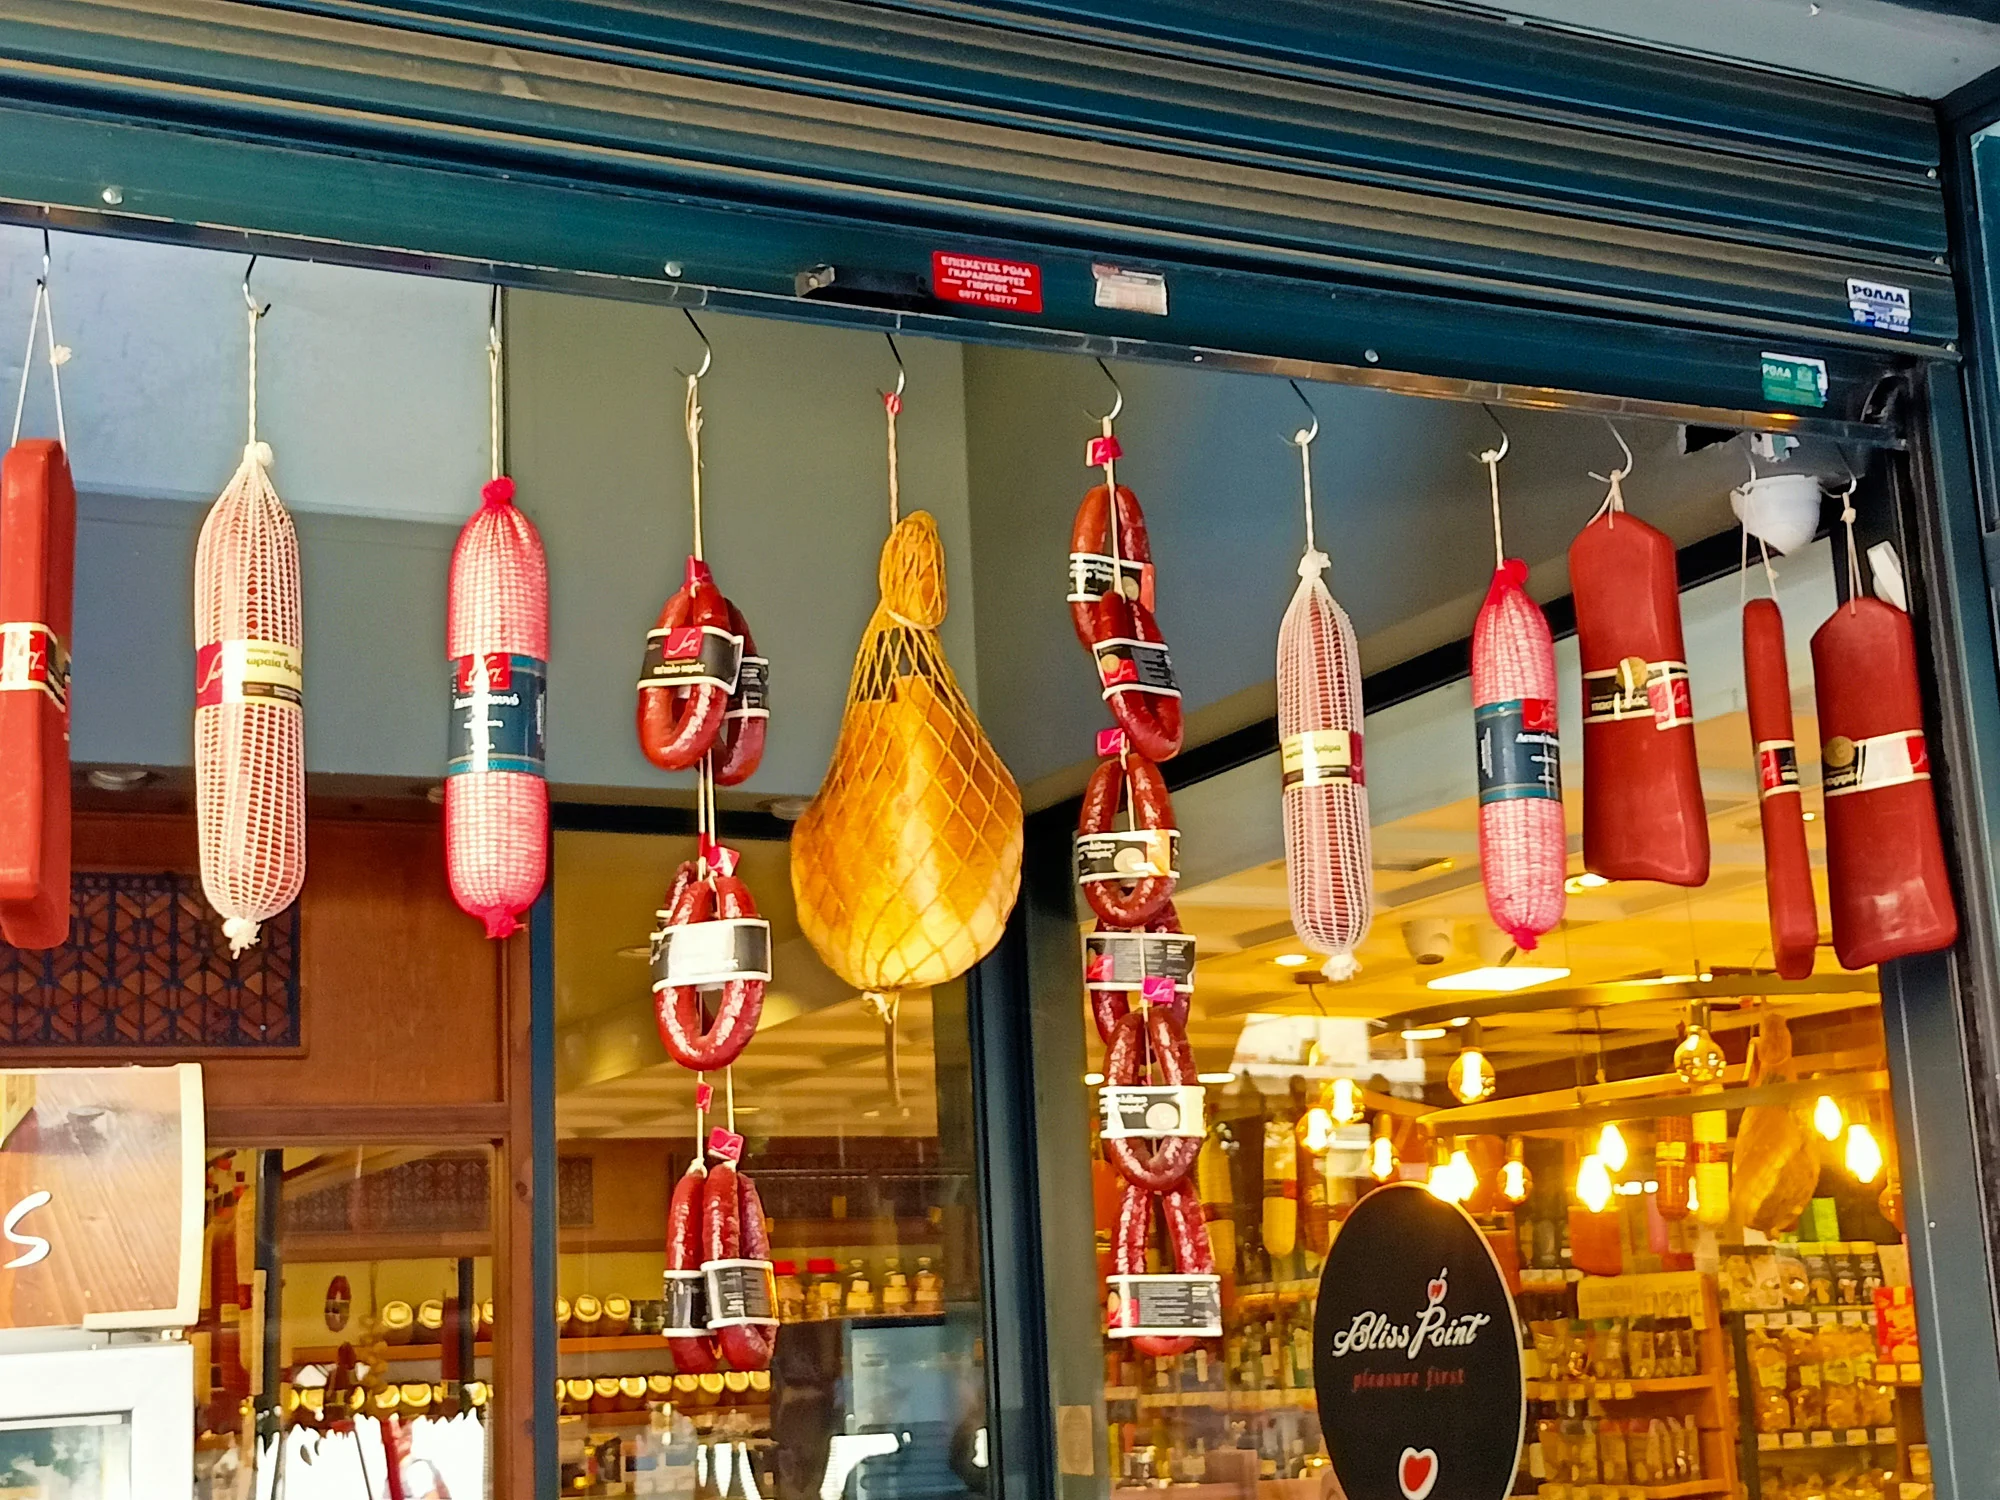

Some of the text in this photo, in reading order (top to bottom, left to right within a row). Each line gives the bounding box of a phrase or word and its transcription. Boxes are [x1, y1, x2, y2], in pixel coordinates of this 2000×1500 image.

[1852, 284, 1906, 304] ΡΟΛΛΑ
[1331, 1303, 1491, 1360] Bliss Point
[1352, 1367, 1464, 1393] pleasure first
